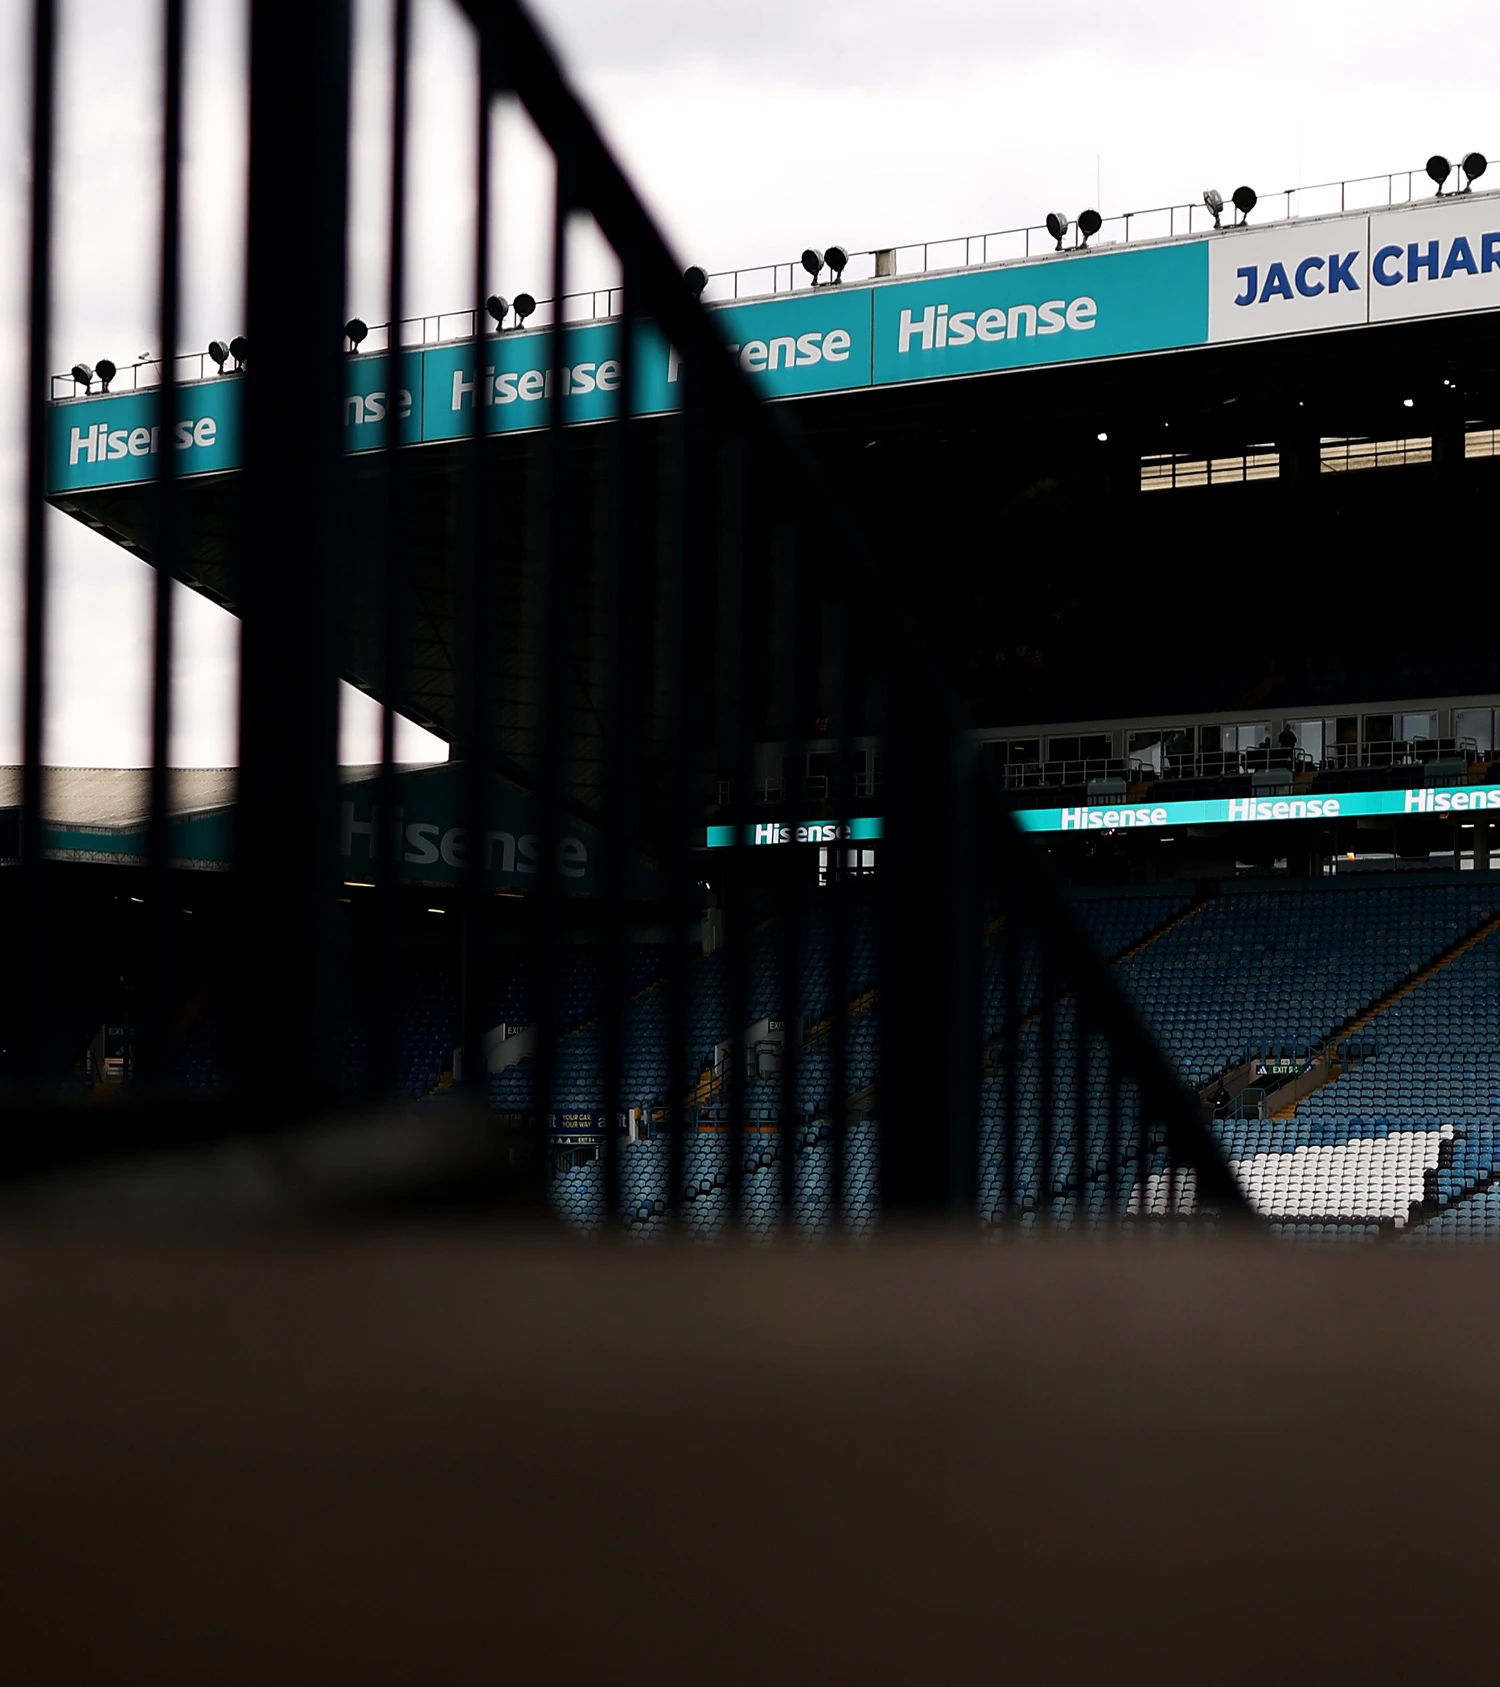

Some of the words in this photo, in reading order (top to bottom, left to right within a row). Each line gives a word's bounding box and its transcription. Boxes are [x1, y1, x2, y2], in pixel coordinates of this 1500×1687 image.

[1234, 250, 1360, 307] JACK
[898, 296, 1097, 352] Hisense
[667, 328, 852, 384] ense
[451, 359, 623, 411] Hisense
[1061, 806, 1168, 830] Hisense
[1227, 797, 1340, 822] Hisense
[1272, 1066, 1287, 1074] EXIT
